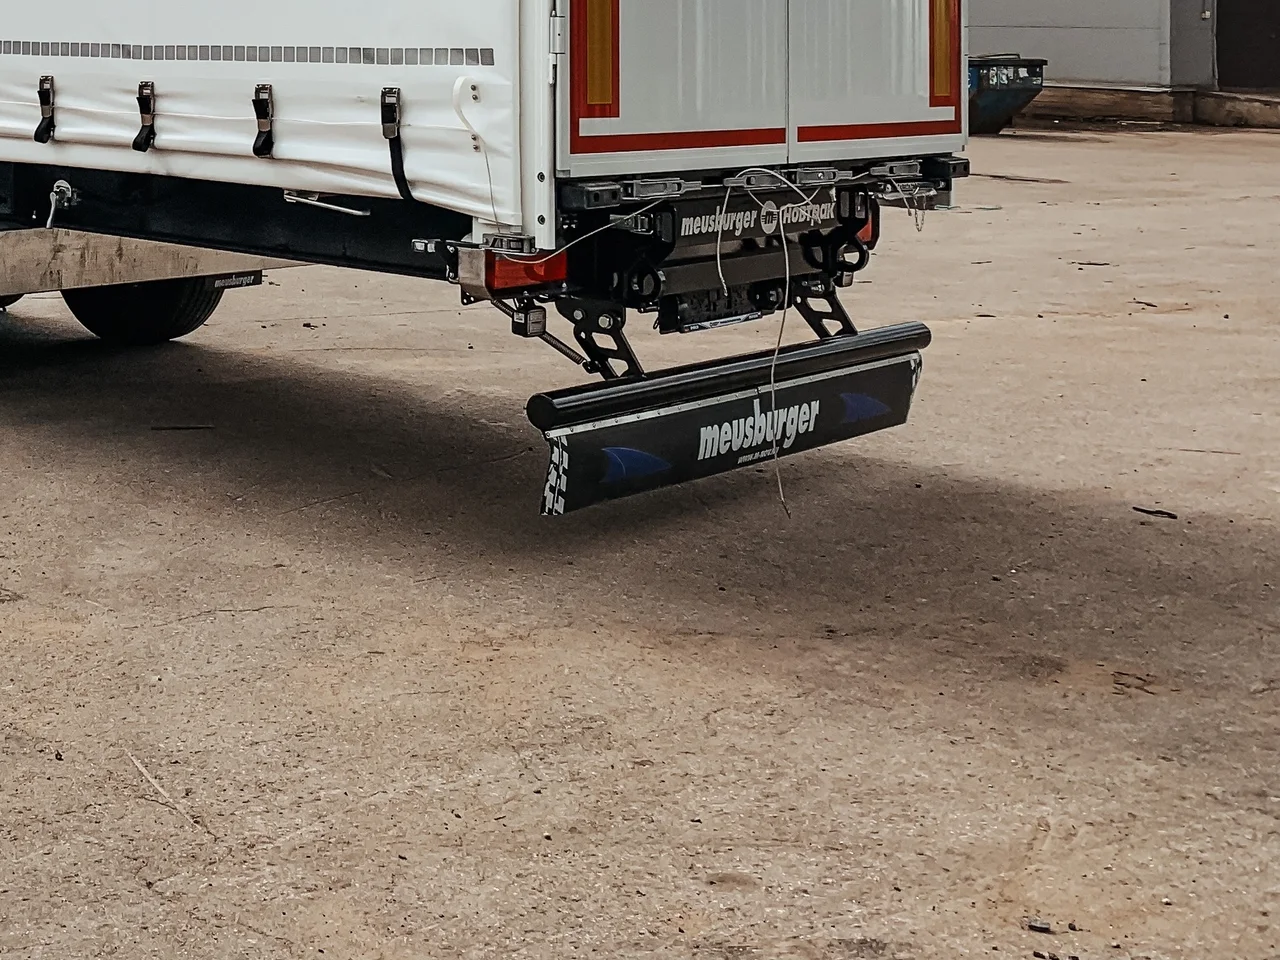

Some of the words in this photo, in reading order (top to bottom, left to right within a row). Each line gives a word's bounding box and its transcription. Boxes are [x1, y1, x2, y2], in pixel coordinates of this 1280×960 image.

[680, 205, 758, 237] meusburger
[214, 274, 255, 288] meusburger
[697, 398, 820, 461] meusburger
